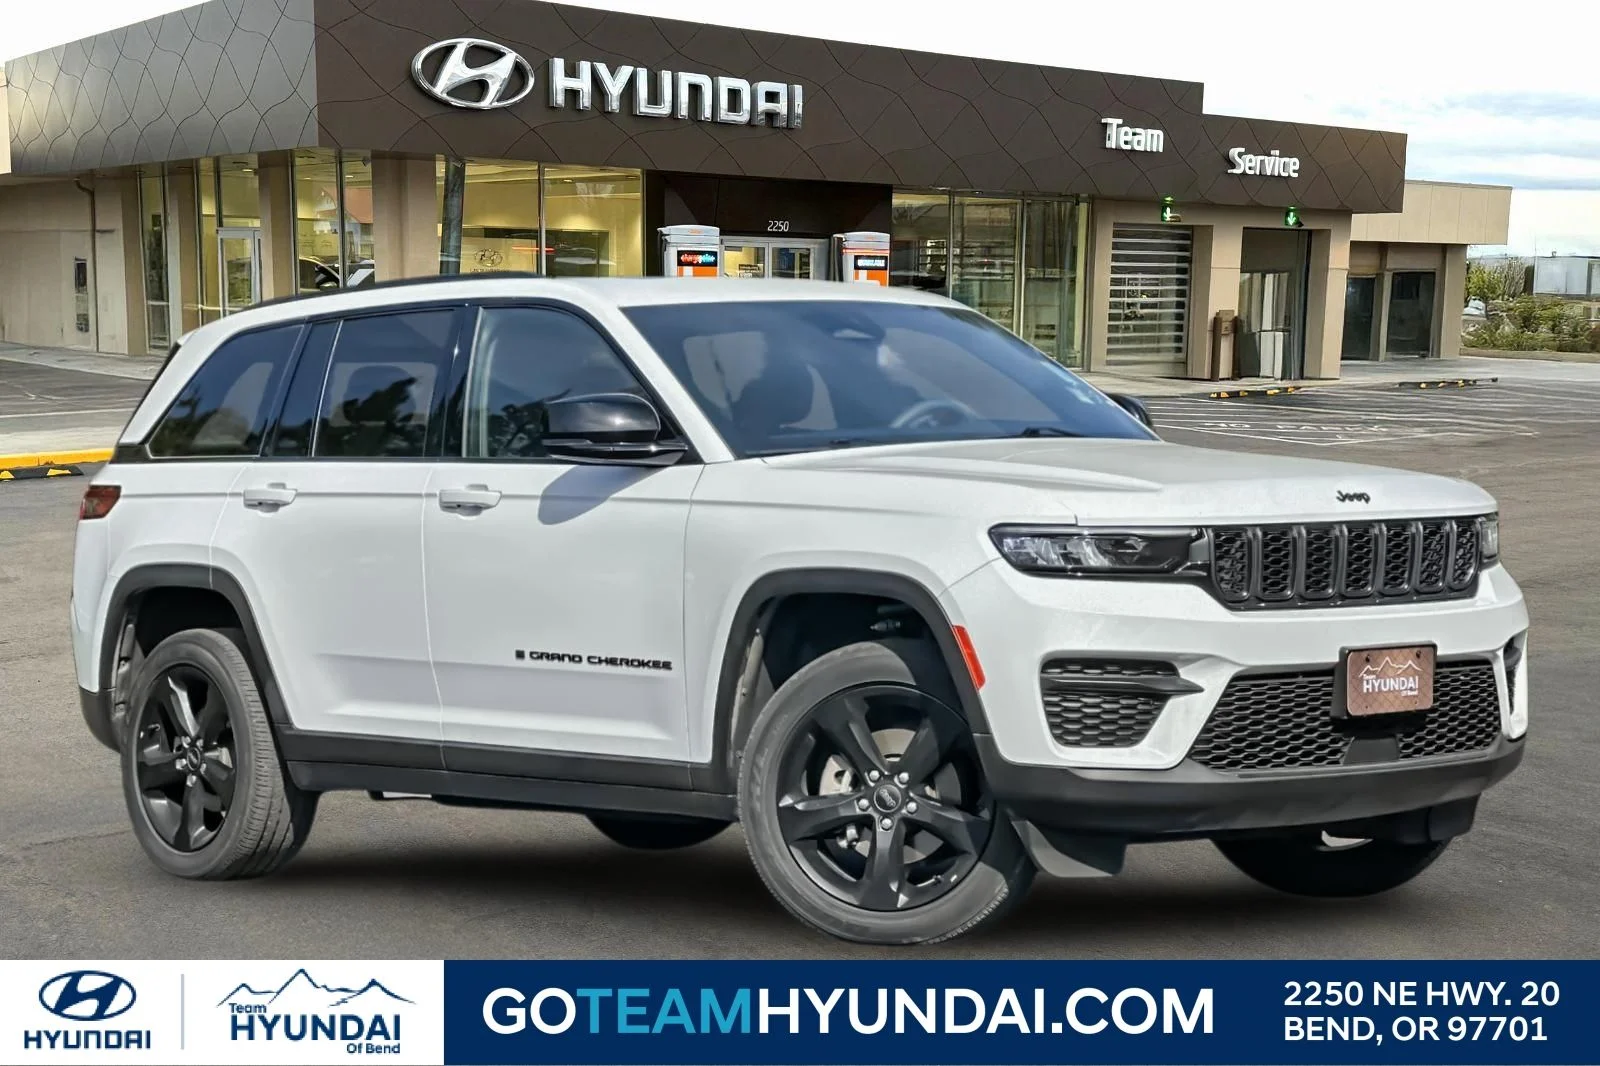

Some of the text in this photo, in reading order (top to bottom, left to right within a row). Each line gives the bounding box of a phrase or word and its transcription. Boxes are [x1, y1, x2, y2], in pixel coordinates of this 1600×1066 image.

[549, 57, 803, 129] HYUNDAI
[1101, 118, 1164, 152] Team
[1227, 147, 1300, 178] Service
[767, 220, 790, 232] 2250
[1336, 490, 1371, 504] Jeep
[529, 651, 673, 671] GRAND CHEROKEE
[1363, 676, 1419, 693] HYUNDAI
